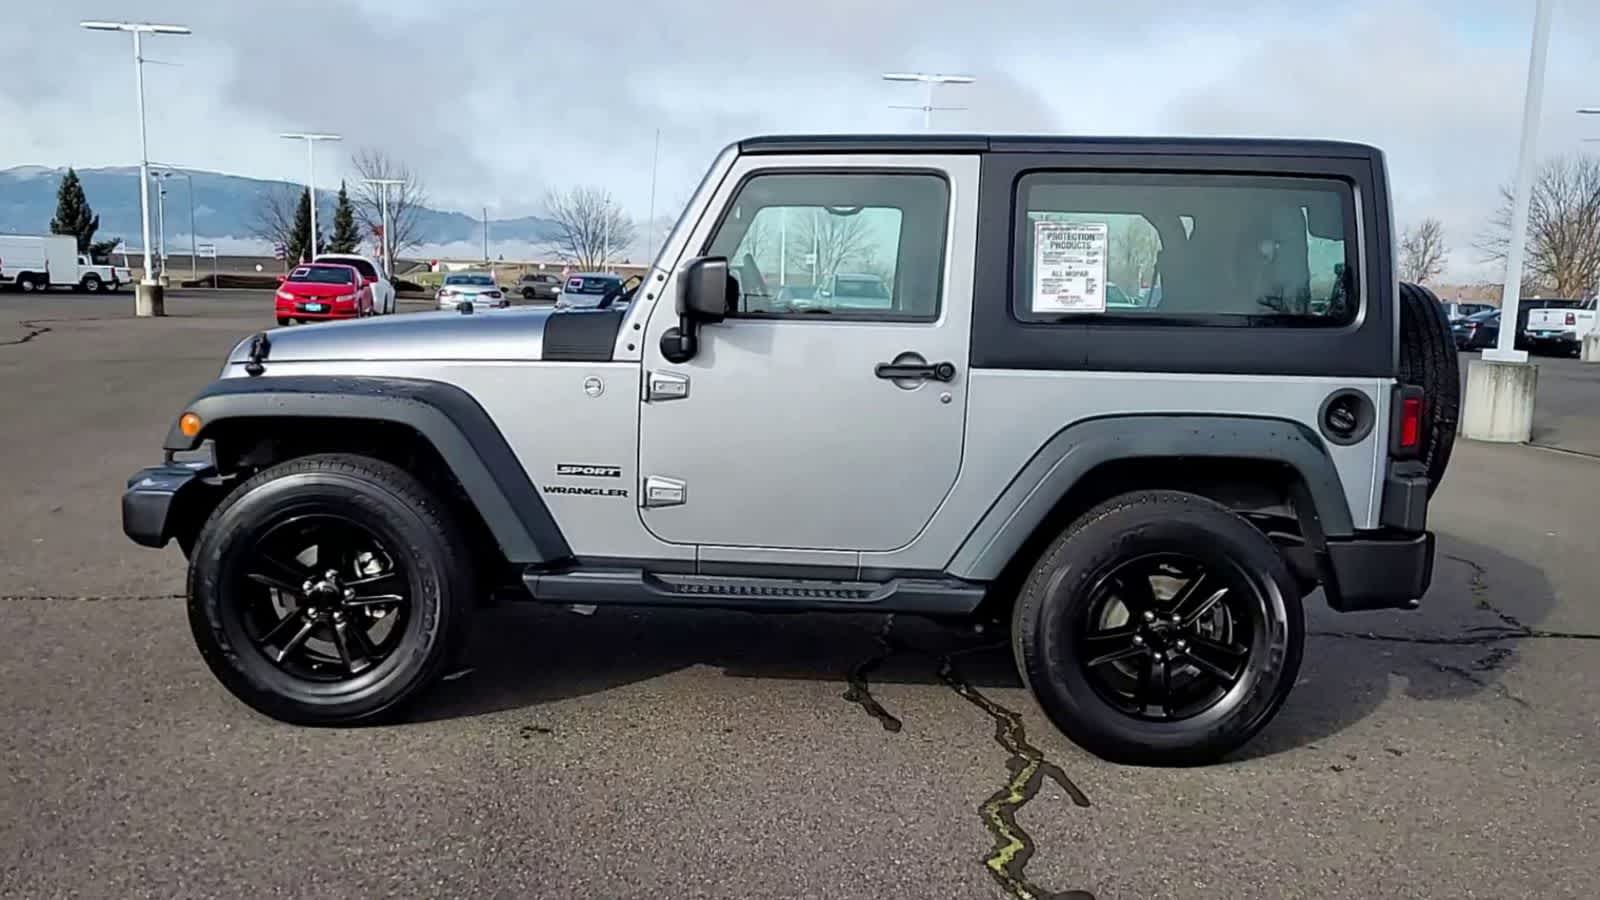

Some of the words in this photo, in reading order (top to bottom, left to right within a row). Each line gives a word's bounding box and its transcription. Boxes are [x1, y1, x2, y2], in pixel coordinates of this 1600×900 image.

[1047, 232, 1095, 241] PROTECTION
[1050, 241, 1092, 249] PRODUCTS
[560, 466, 619, 476] SPORT
[543, 486, 628, 497] WRANGLER
